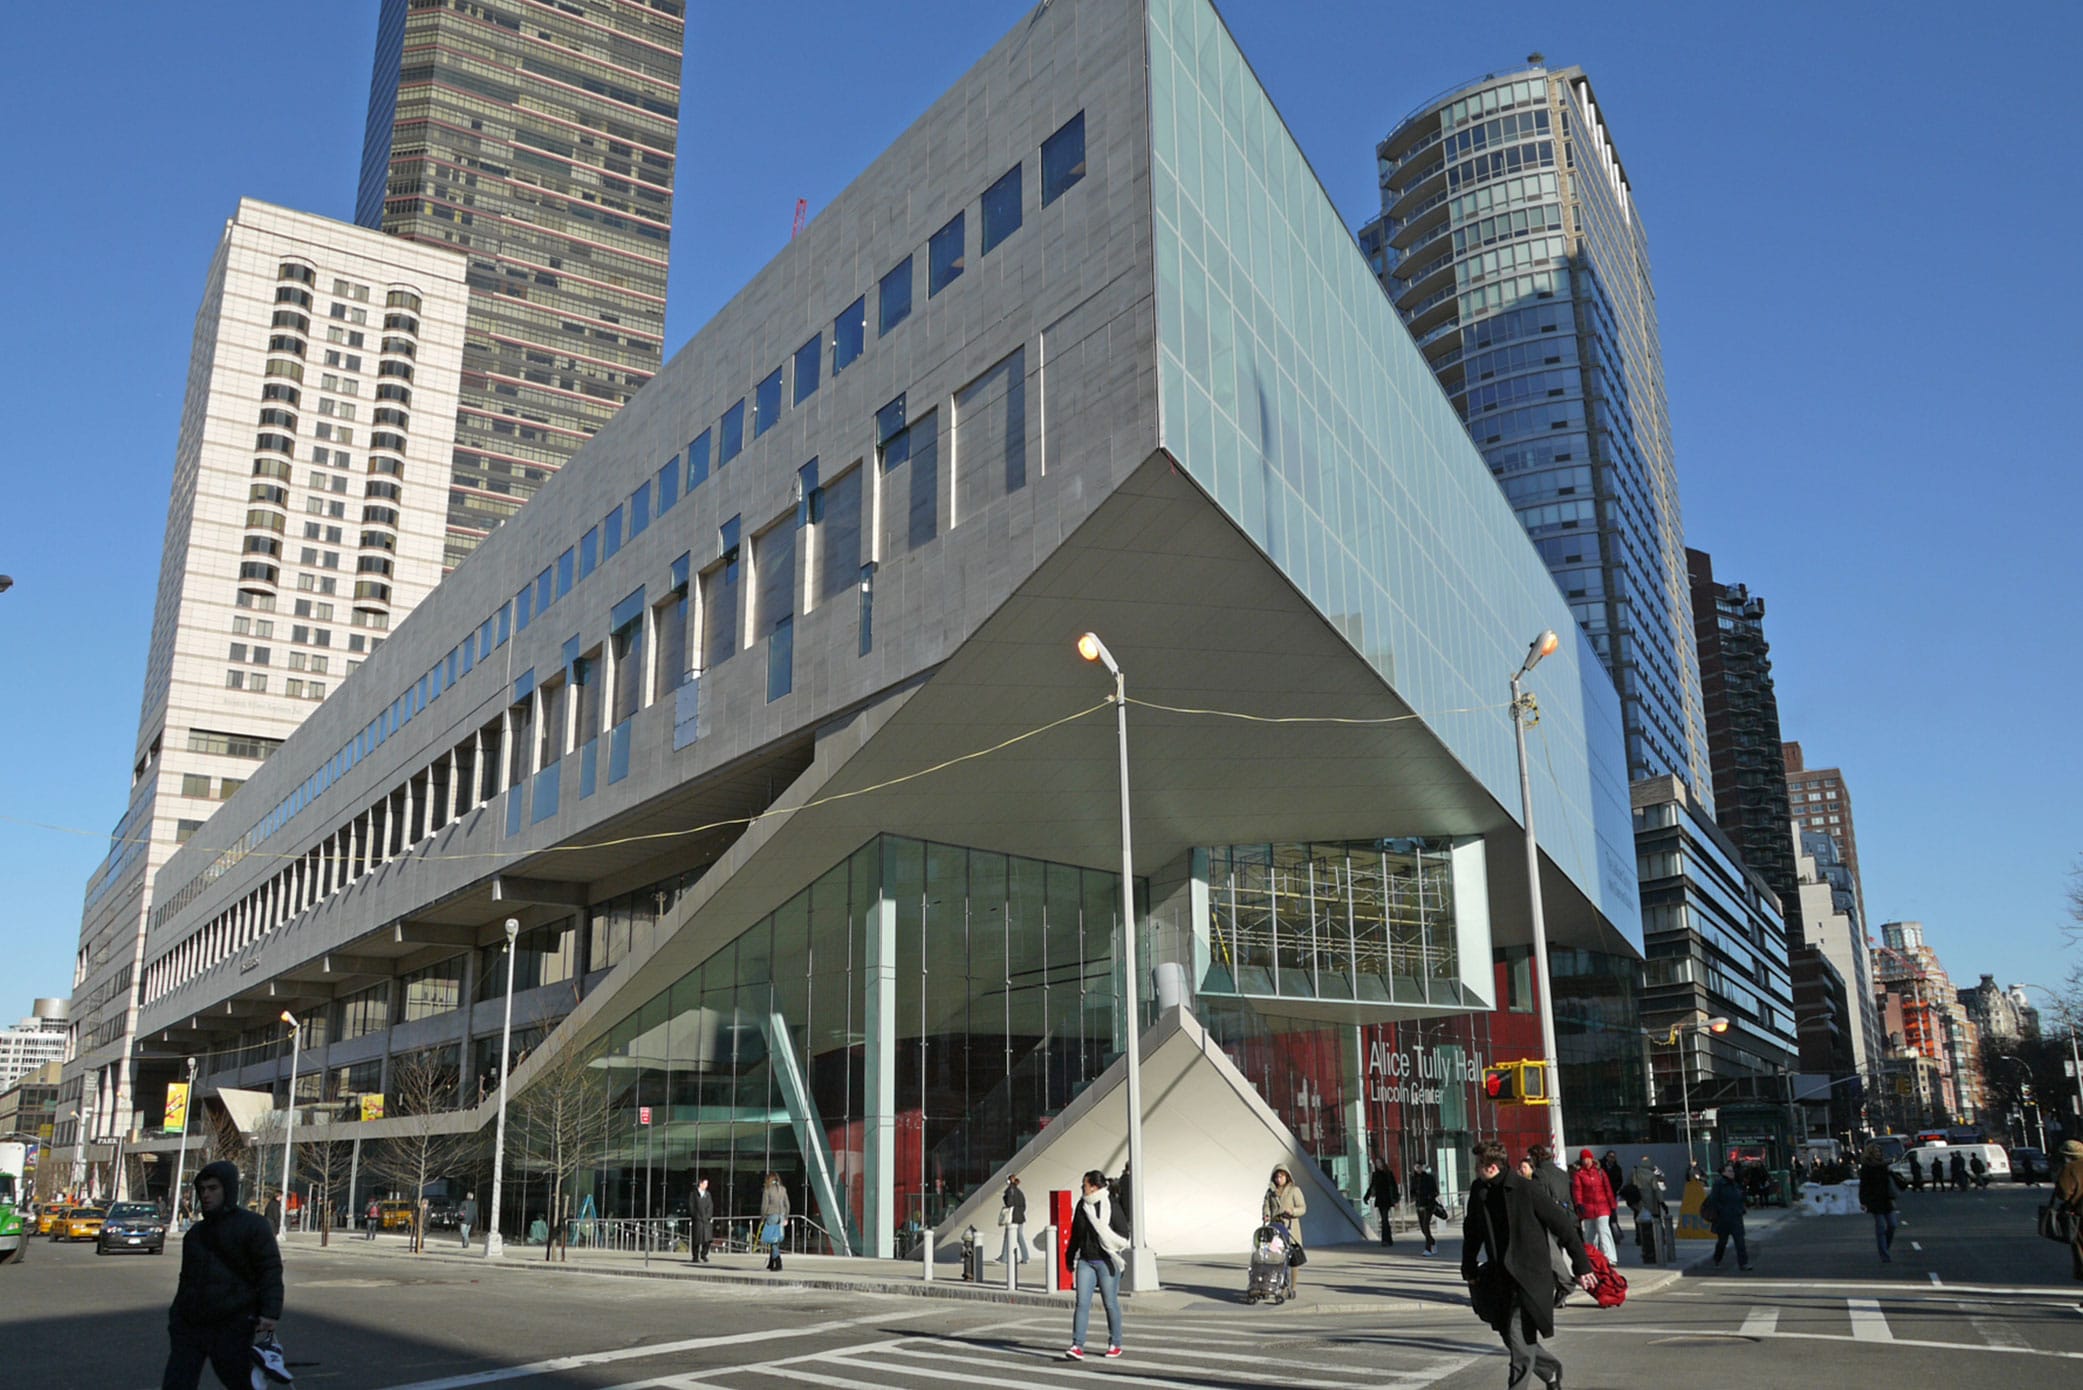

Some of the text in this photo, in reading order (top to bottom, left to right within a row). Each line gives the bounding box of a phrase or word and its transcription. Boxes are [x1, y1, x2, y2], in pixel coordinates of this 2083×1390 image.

[1369, 1041, 1484, 1087] Alice Tully Hall
[1371, 1080, 1444, 1105] Lincoln Center
